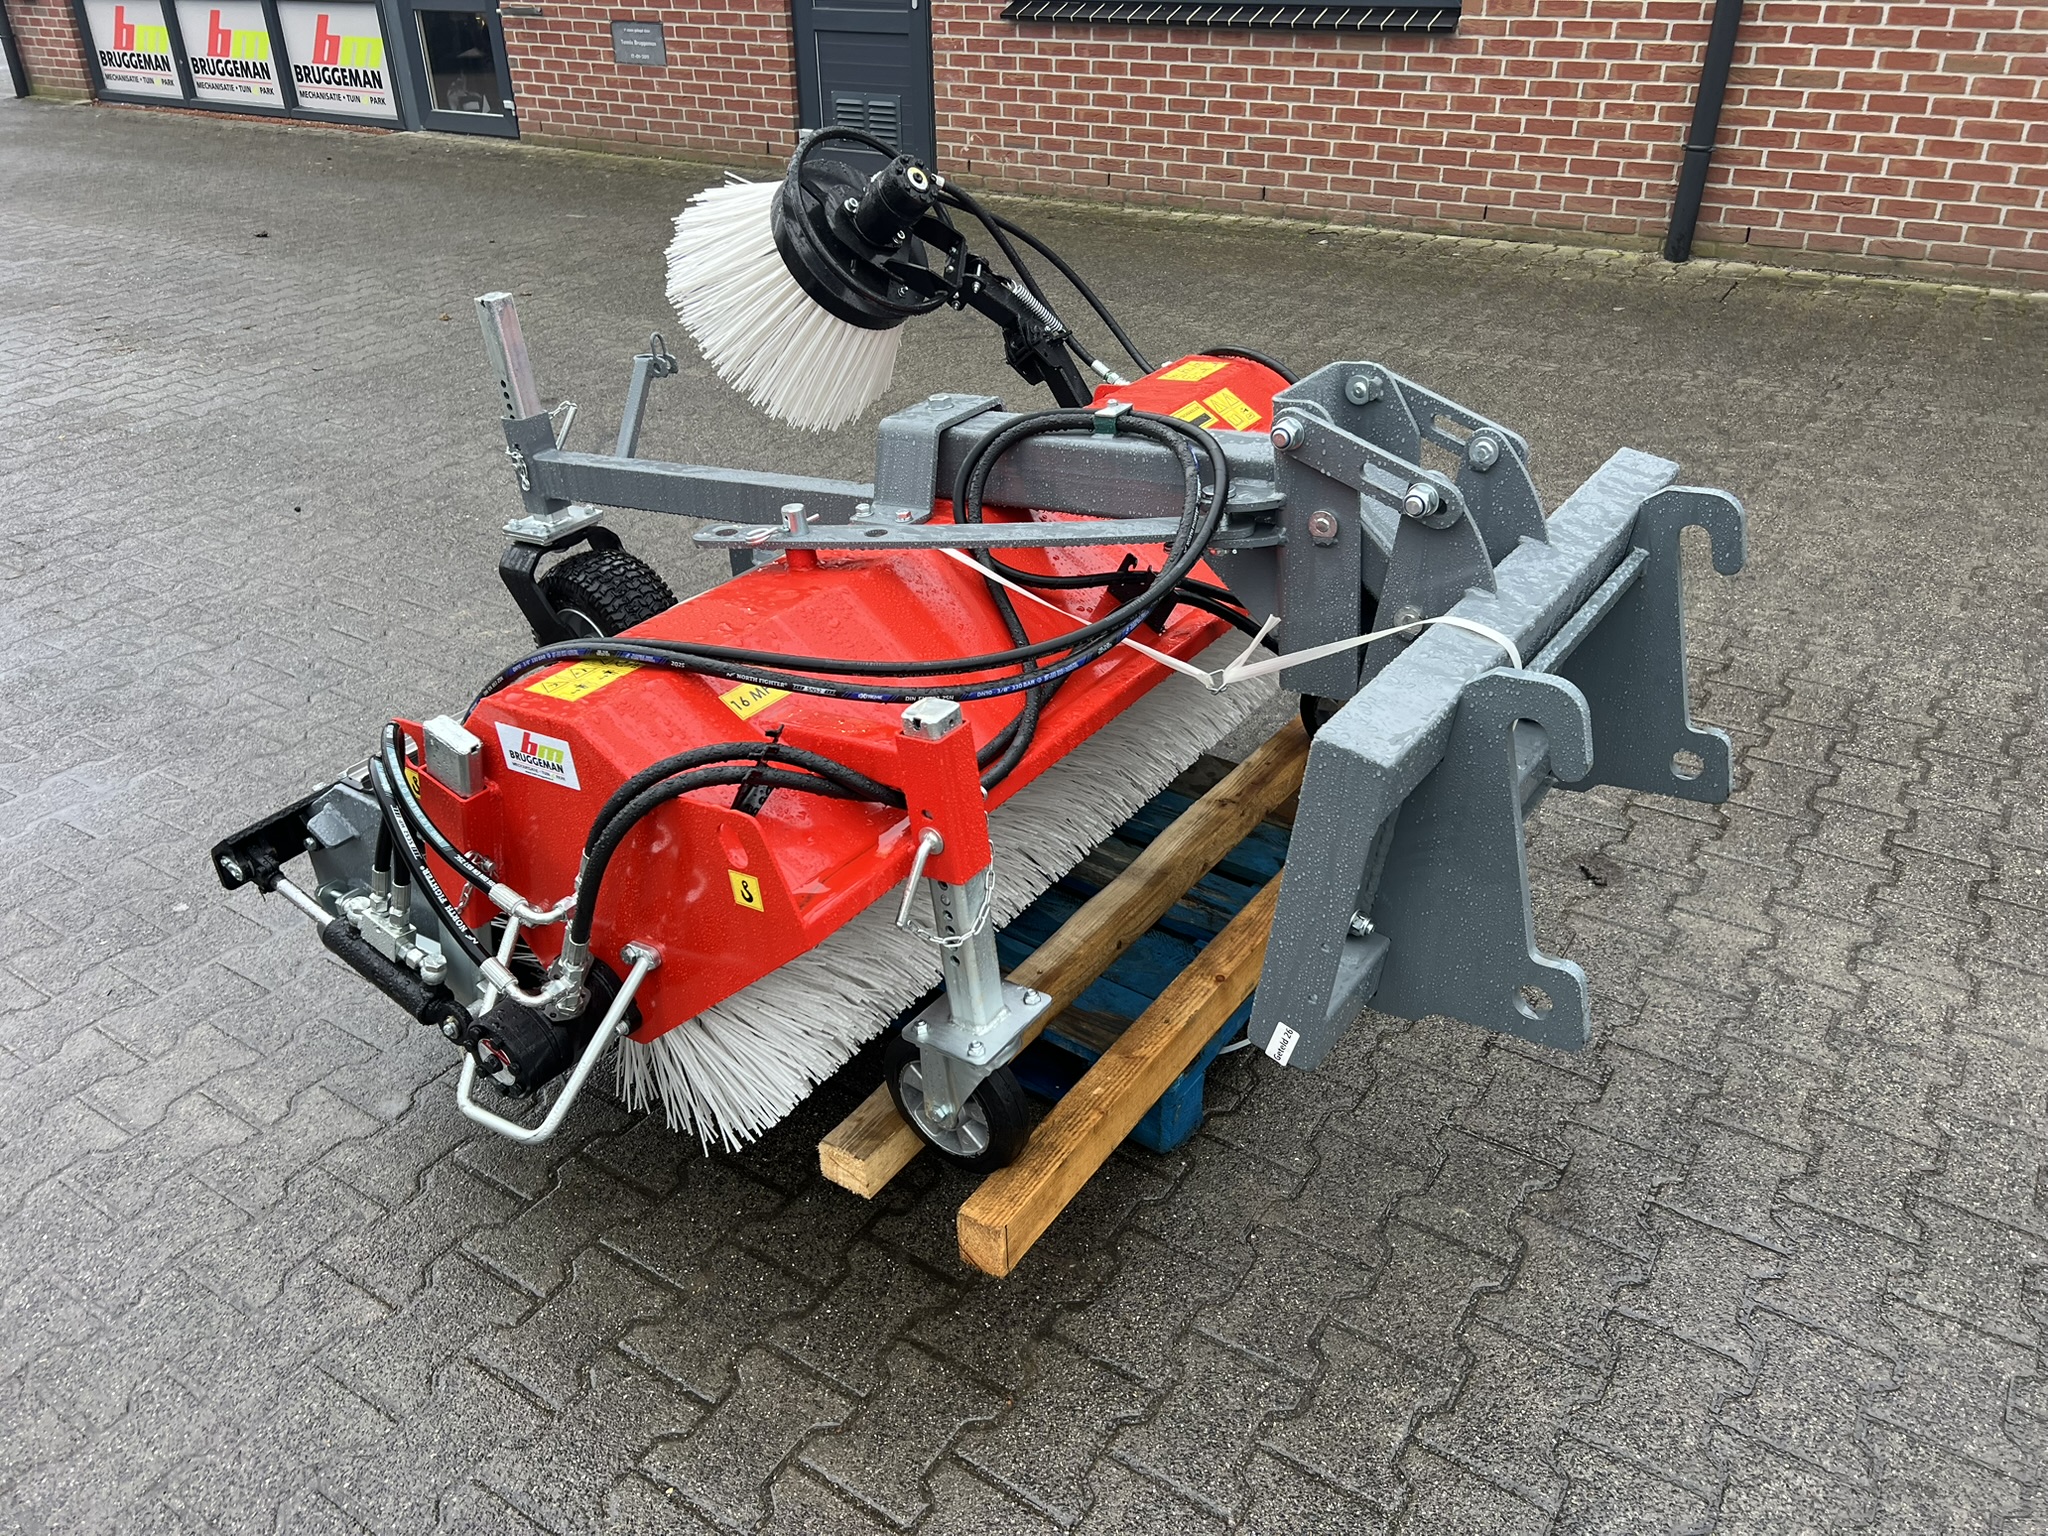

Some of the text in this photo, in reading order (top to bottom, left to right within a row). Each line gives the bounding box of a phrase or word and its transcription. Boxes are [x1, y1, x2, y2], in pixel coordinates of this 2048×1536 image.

[113, 5, 169, 54] bm
[207, 9, 269, 61] bm
[312, 14, 383, 69] bm
[99, 50, 171, 72] BRUGGEMAN
[191, 57, 271, 80] BRUGGEMAN
[105, 73, 175, 86] MECHANISATIE TUIN PARK
[196, 81, 274, 95] MECHANISATIE TUIN PARK
[294, 64, 383, 89] BRUGGEMAN
[299, 90, 386, 105] MECHANISATIE TUIN PARK
[736, 673, 758, 683] NORTH
[1023, 680, 1035, 688] BAR
[730, 696, 751, 711] 16
[520, 731, 564, 764] bm
[509, 749, 564, 774] BRUGGEMAN
[444, 904, 467, 932] NORTH
[1273, 1028, 1293, 1061] Geteld 26
